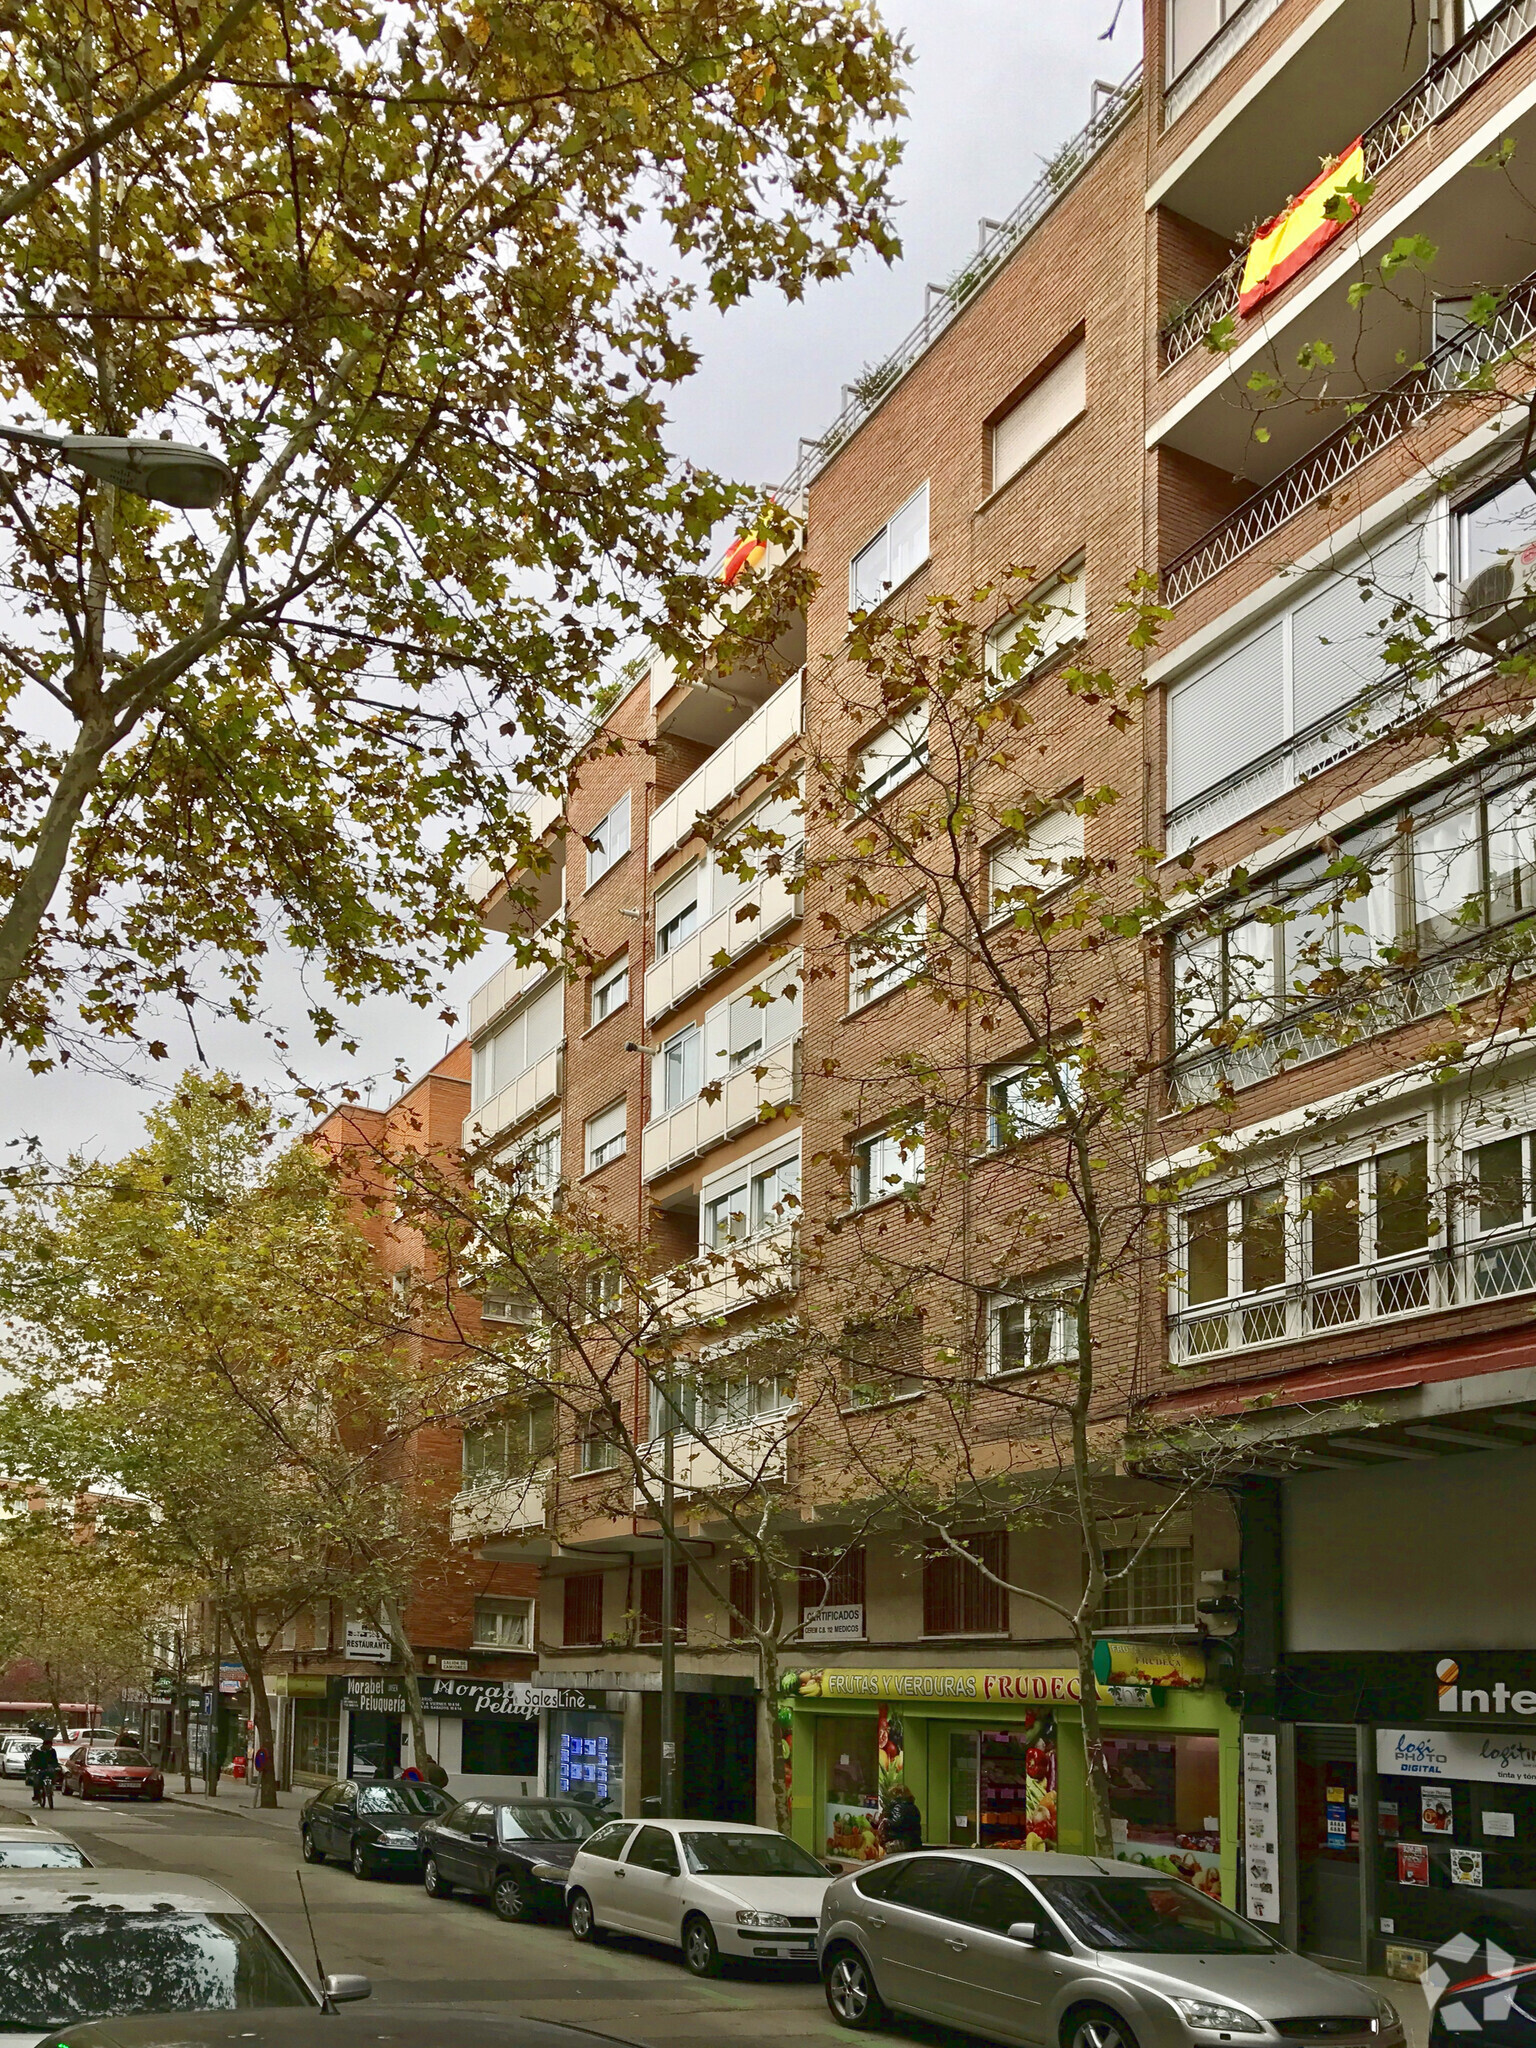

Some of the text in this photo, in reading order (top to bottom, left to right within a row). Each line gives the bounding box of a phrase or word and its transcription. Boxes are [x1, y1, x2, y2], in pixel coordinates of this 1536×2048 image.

[834, 1625, 859, 1633] MEDICOS
[346, 1639, 391, 1650] RESTAURANTE
[347, 1677, 385, 1695] Morabet
[828, 1674, 1102, 1701] FRUTAS Y VERDURAS FRUDEC
[1400, 1763, 1442, 1774] DIGITAL
[1497, 1771, 1515, 1779] tinta
